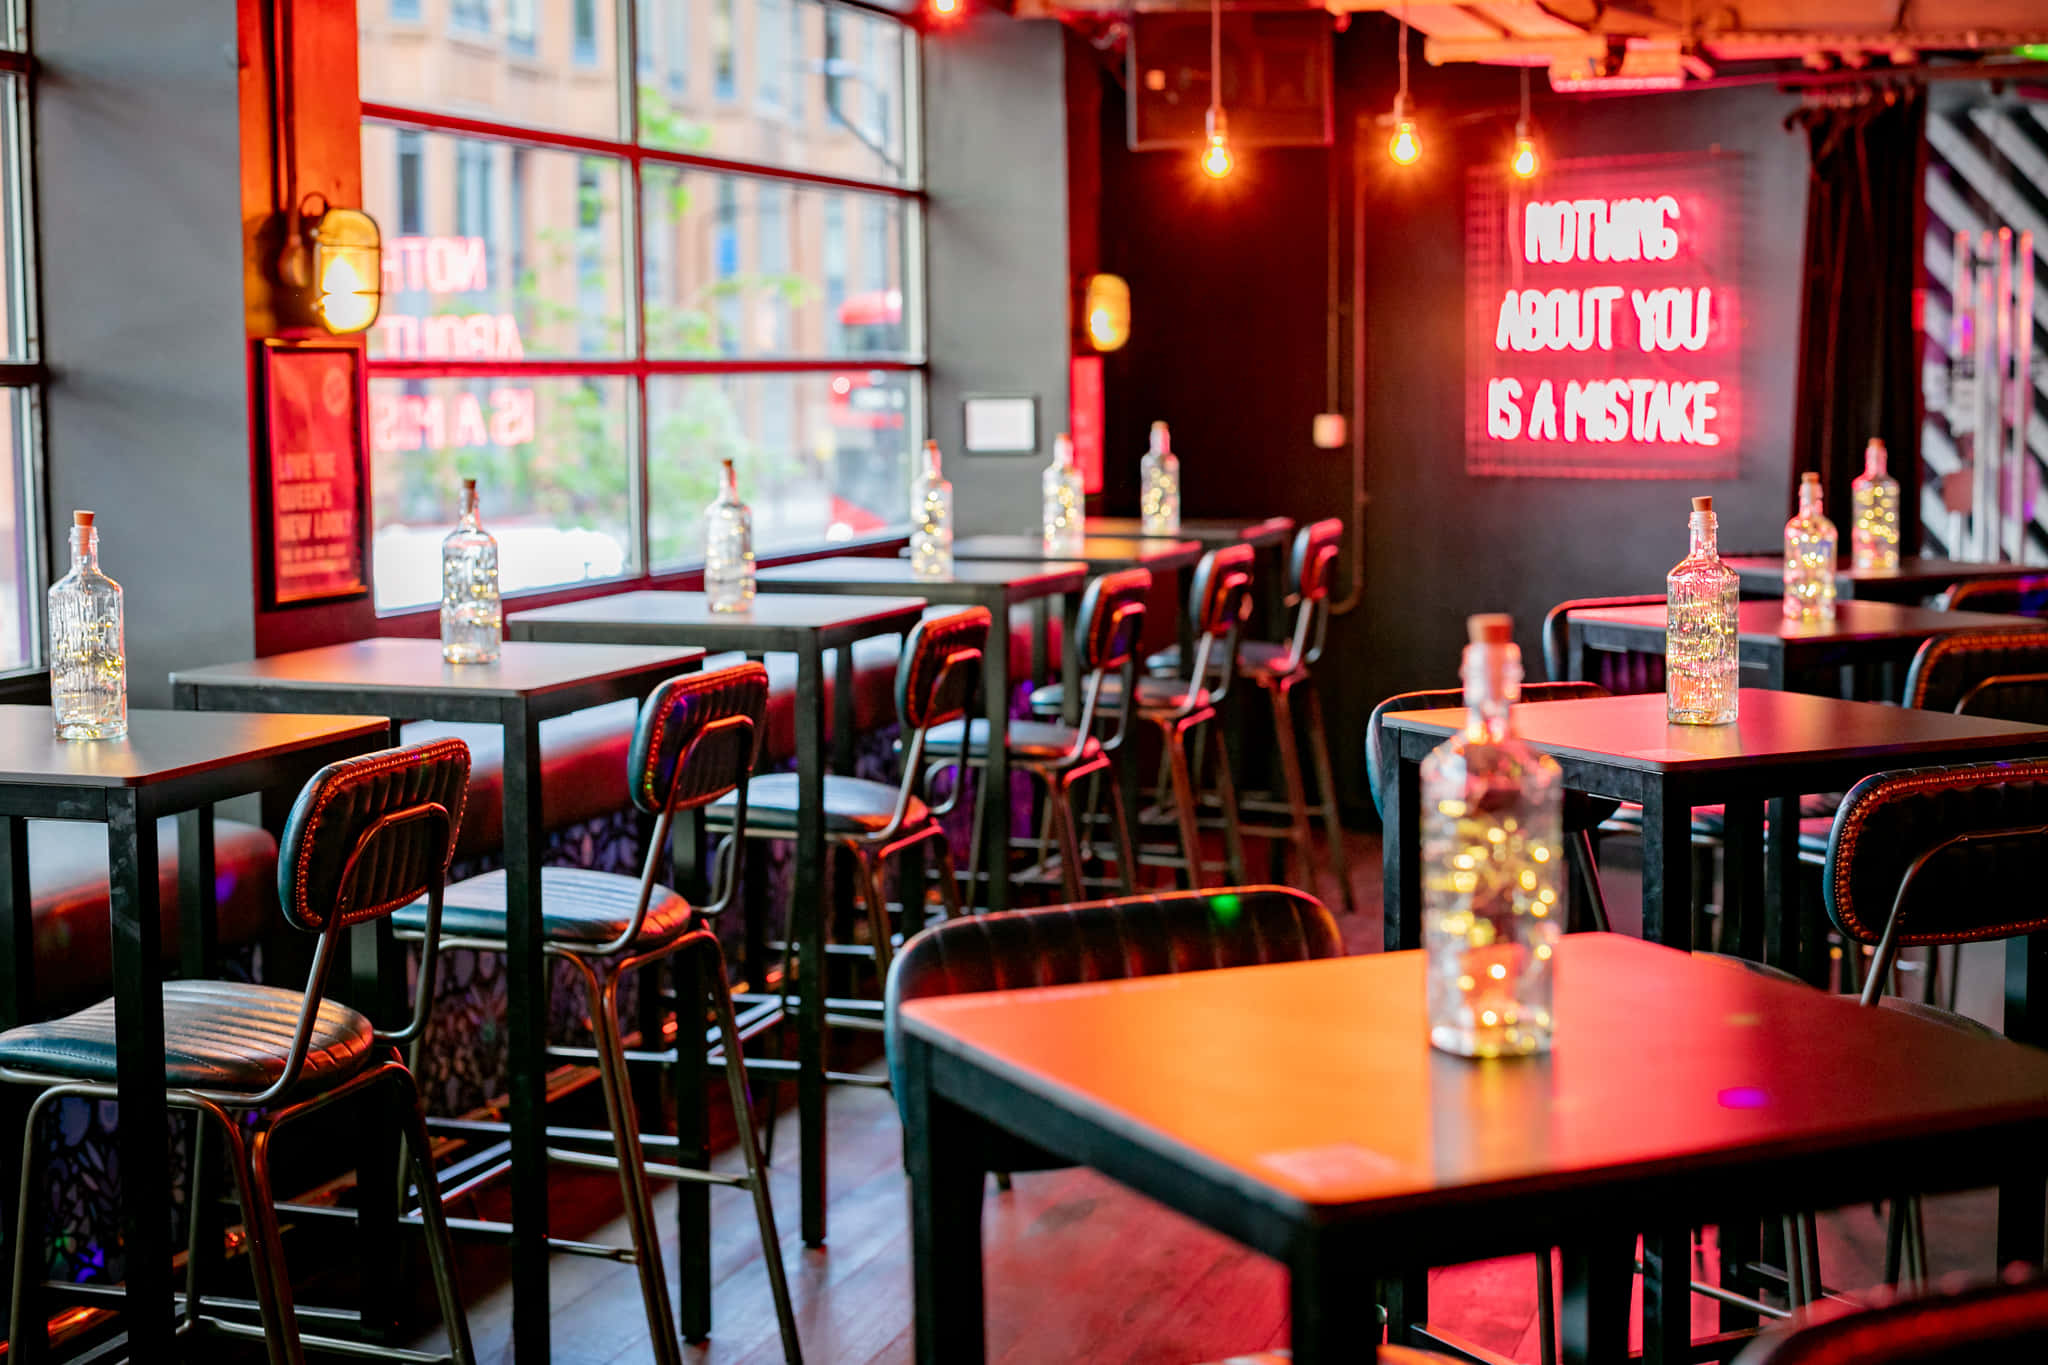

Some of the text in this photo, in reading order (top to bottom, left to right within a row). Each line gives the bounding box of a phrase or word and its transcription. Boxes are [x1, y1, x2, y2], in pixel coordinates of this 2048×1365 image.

[1525, 196, 1680, 263] NOTHING
[1496, 286, 1711, 352] ABOUT YOU
[1488, 378, 1720, 446] IS A MISTAKE
